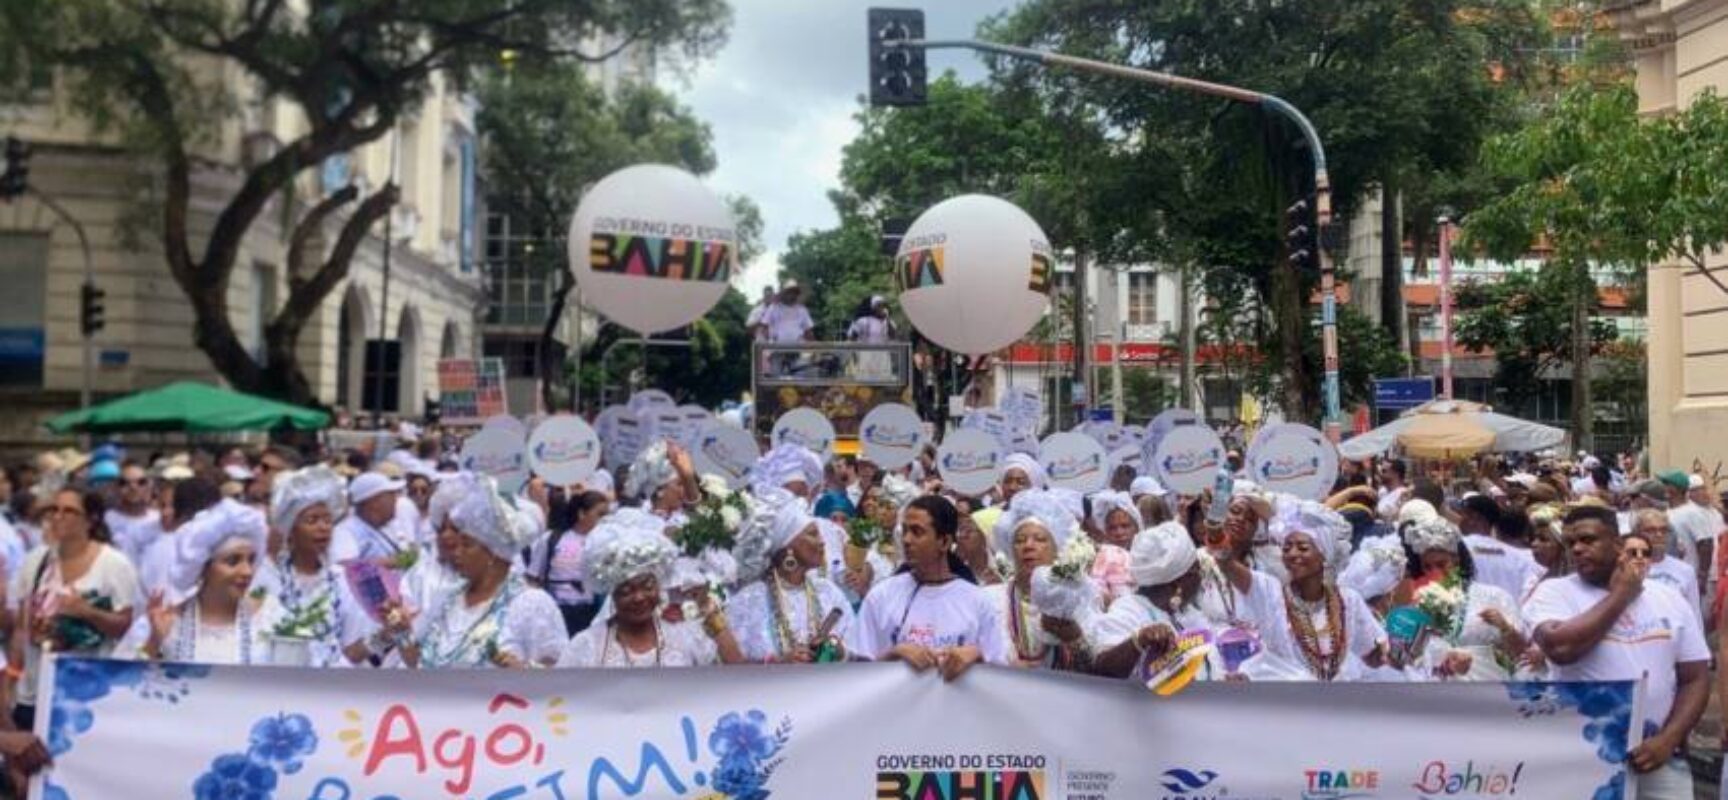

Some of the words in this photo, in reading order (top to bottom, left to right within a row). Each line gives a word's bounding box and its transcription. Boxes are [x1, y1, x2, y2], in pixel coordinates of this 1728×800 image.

[363, 693, 545, 795] Agô,
[876, 755, 955, 769] GOVERNO
[959, 755, 982, 769] DO
[986, 755, 1046, 769] ESTADO
[1305, 770, 1378, 790] TRADE
[1412, 759, 1525, 795] Bahia!
